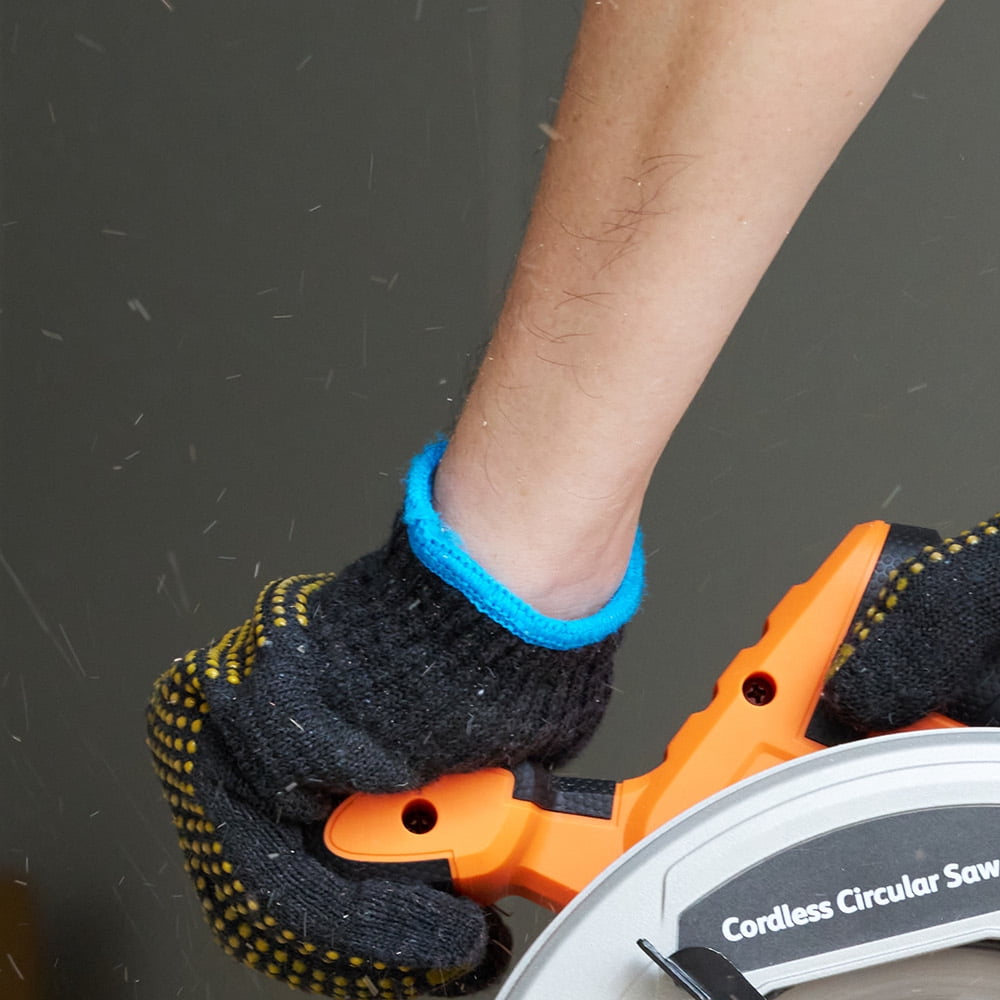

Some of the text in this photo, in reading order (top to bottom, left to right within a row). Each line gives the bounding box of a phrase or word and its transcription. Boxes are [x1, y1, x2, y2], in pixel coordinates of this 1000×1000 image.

[722, 859, 1000, 942] Cordless Circular Saw
